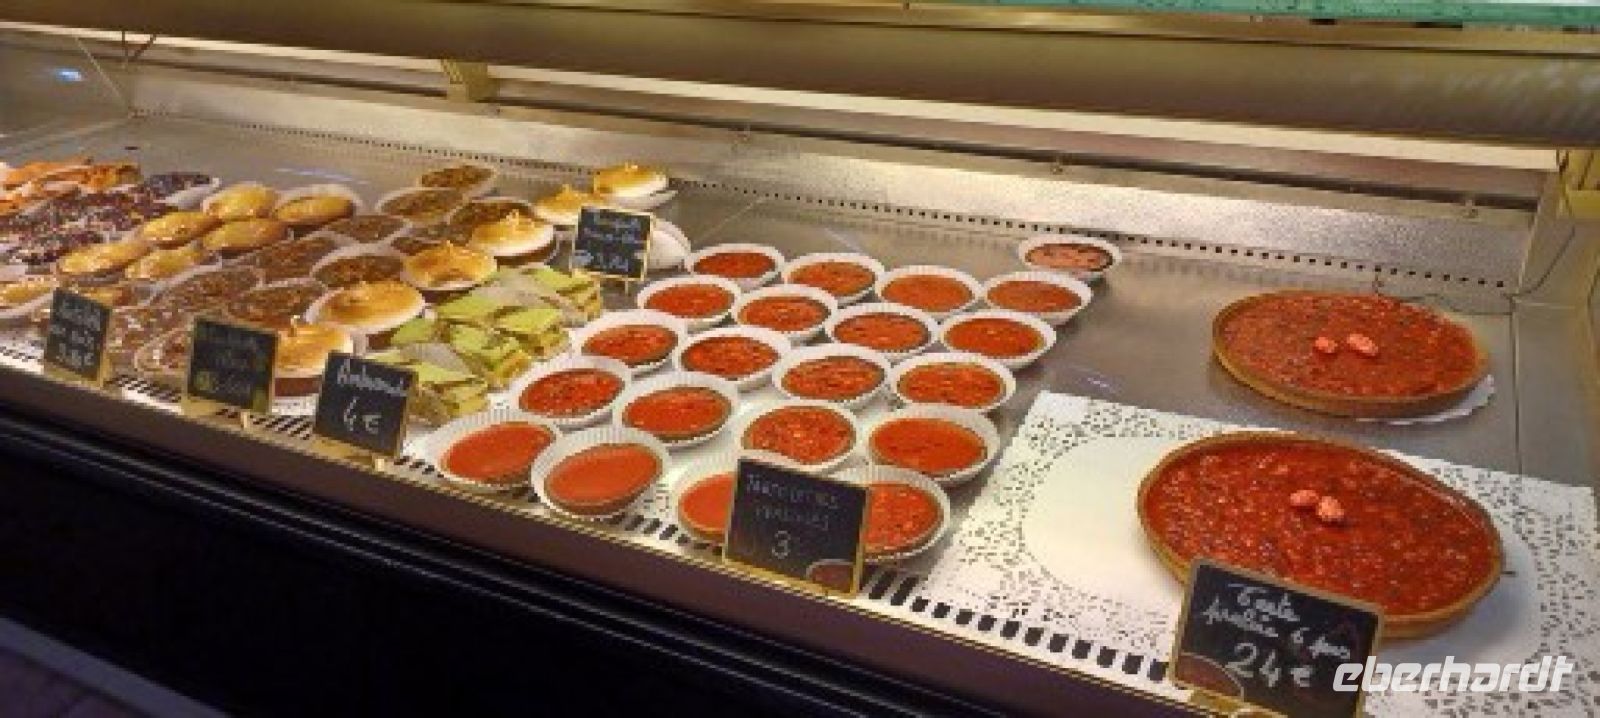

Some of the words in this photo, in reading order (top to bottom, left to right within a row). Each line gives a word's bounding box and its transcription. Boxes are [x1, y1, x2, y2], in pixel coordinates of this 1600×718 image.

[343, 396, 357, 432] 4
[771, 530, 791, 560] 3
[1225, 642, 1281, 688] 24
